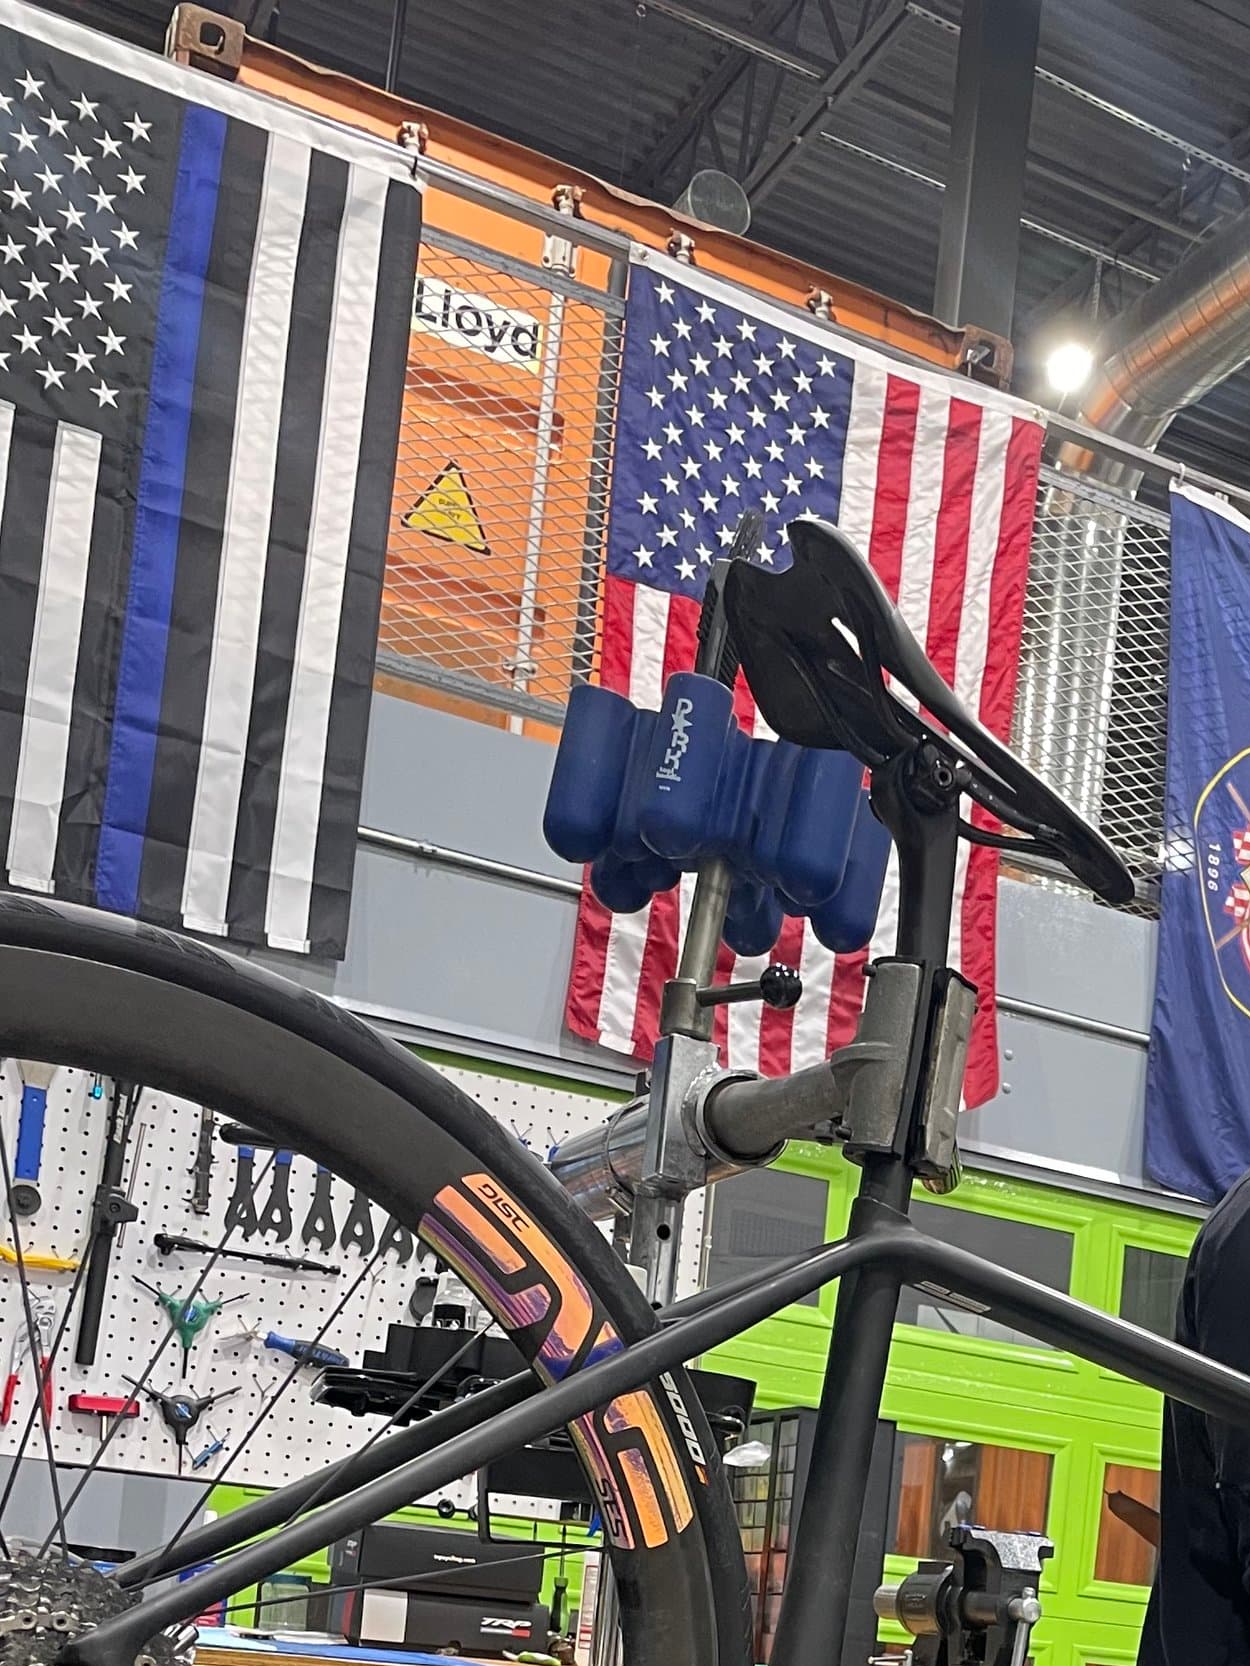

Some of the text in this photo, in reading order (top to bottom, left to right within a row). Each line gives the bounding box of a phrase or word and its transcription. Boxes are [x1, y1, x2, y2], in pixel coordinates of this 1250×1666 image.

[415, 279, 538, 359] Lloyd
[1207, 843, 1221, 892] 1896
[478, 1182, 531, 1233] DISC
[600, 1477, 625, 1540] SES
[481, 1616, 532, 1630] TRP
